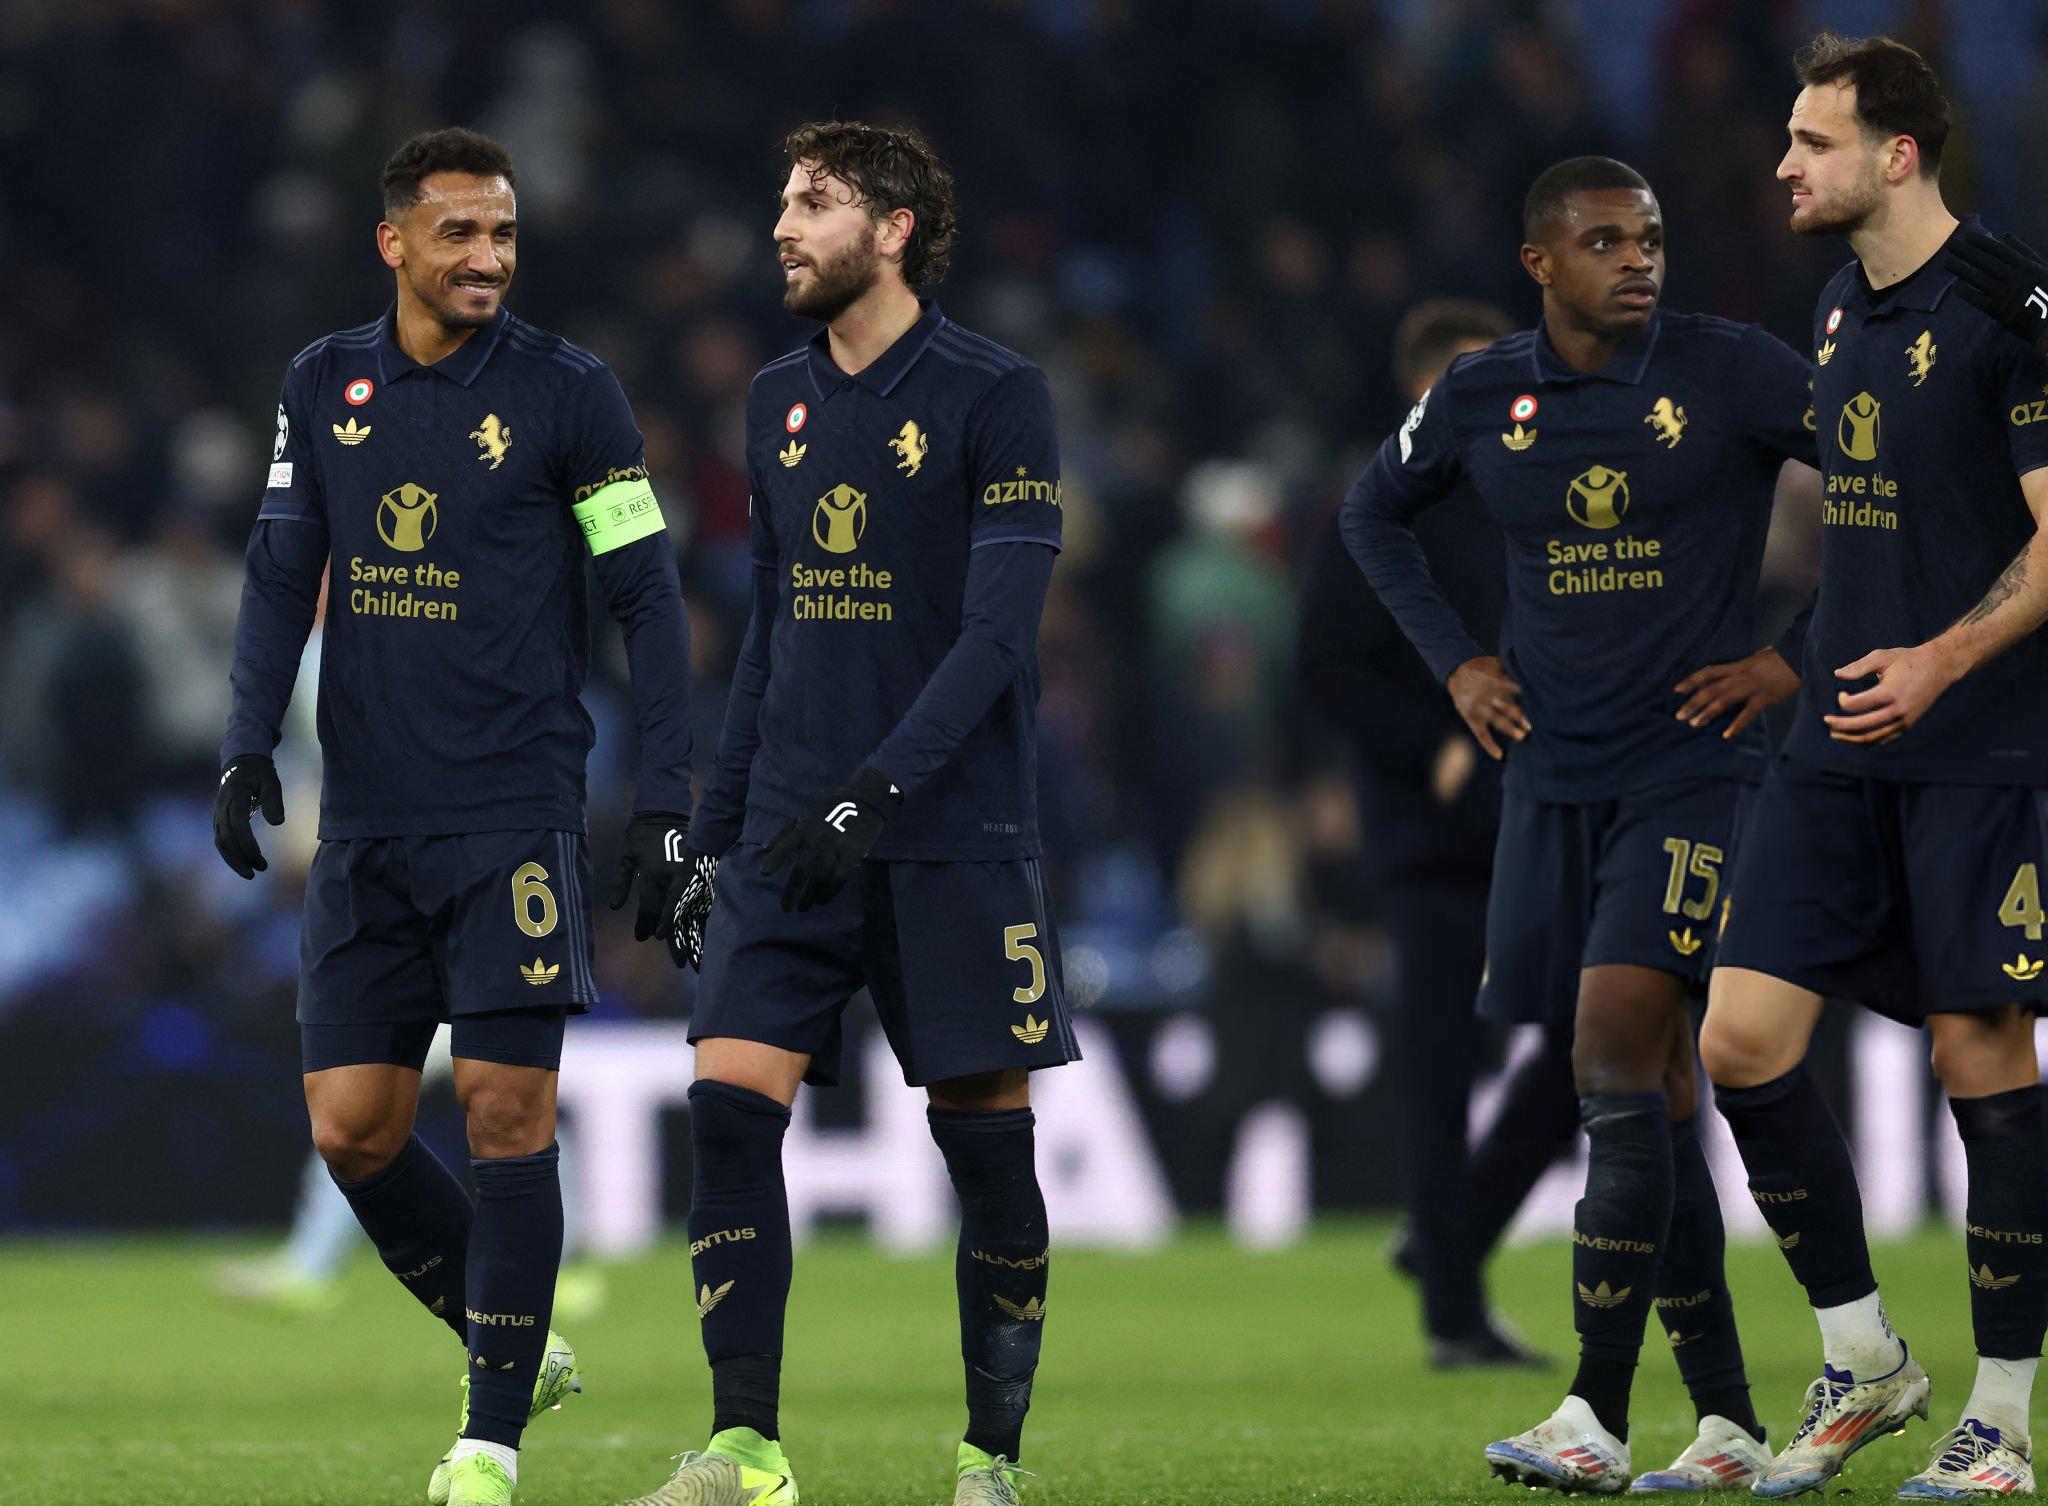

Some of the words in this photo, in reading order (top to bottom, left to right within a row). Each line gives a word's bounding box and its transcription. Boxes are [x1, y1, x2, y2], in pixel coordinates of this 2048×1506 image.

[1825, 472, 1867, 495] ave
[1547, 539, 1609, 565] Save
[1614, 535, 1661, 560] the
[350, 556, 409, 585] Save
[414, 562, 460, 589] the
[792, 562, 845, 589] Save
[849, 563, 892, 589] the
[1548, 567, 1664, 596] Children
[351, 588, 458, 621] Children
[793, 594, 892, 621] Children
[1662, 837, 1724, 921] 15
[511, 861, 559, 938] 6
[1998, 863, 2046, 940] 4
[1003, 922, 1047, 1004] 5
[1749, 1189, 1808, 1203] NTUS
[690, 1227, 756, 1258] ENTUS
[1966, 1223, 2043, 1244] VENTUS
